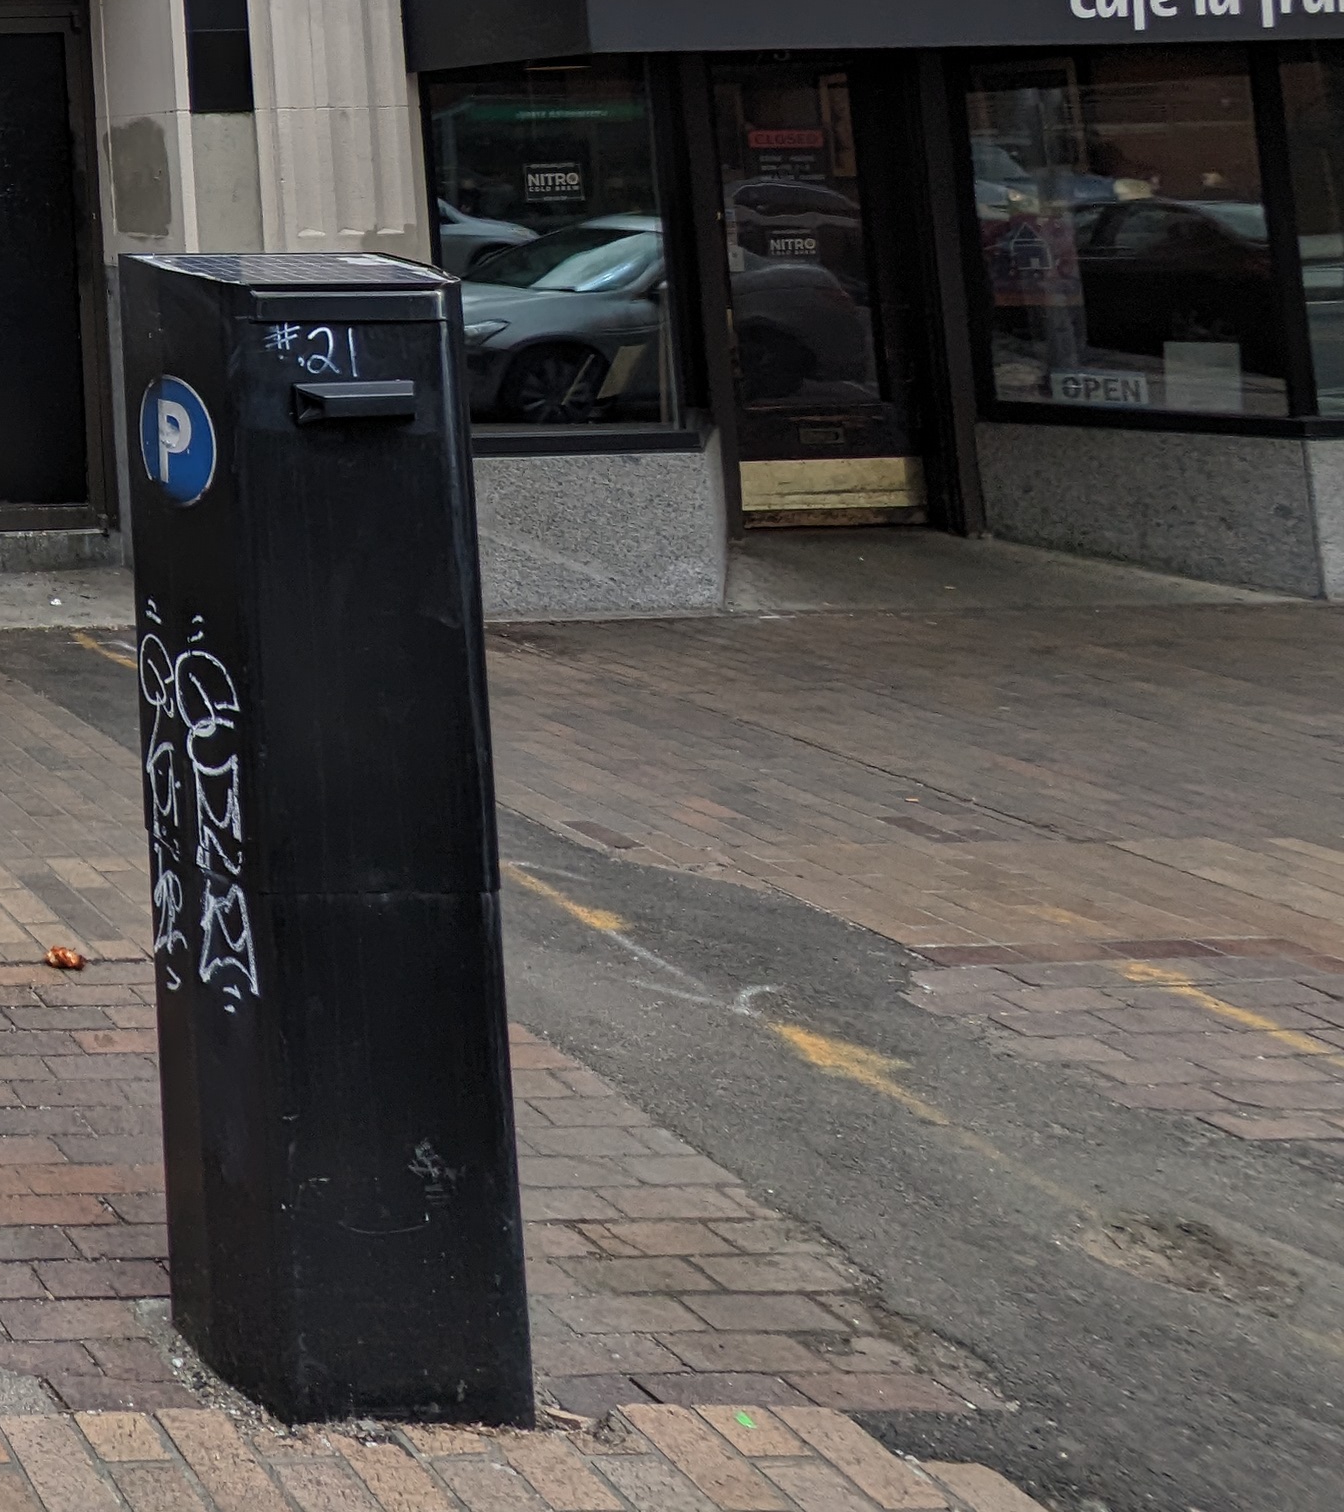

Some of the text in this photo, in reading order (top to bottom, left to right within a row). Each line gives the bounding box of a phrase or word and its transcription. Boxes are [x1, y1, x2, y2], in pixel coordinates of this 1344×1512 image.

[527, 172, 580, 187] NITRO
[769, 237, 817, 251] NITRO
[1061, 376, 1142, 403] OPEN
[156, 396, 193, 484] P
